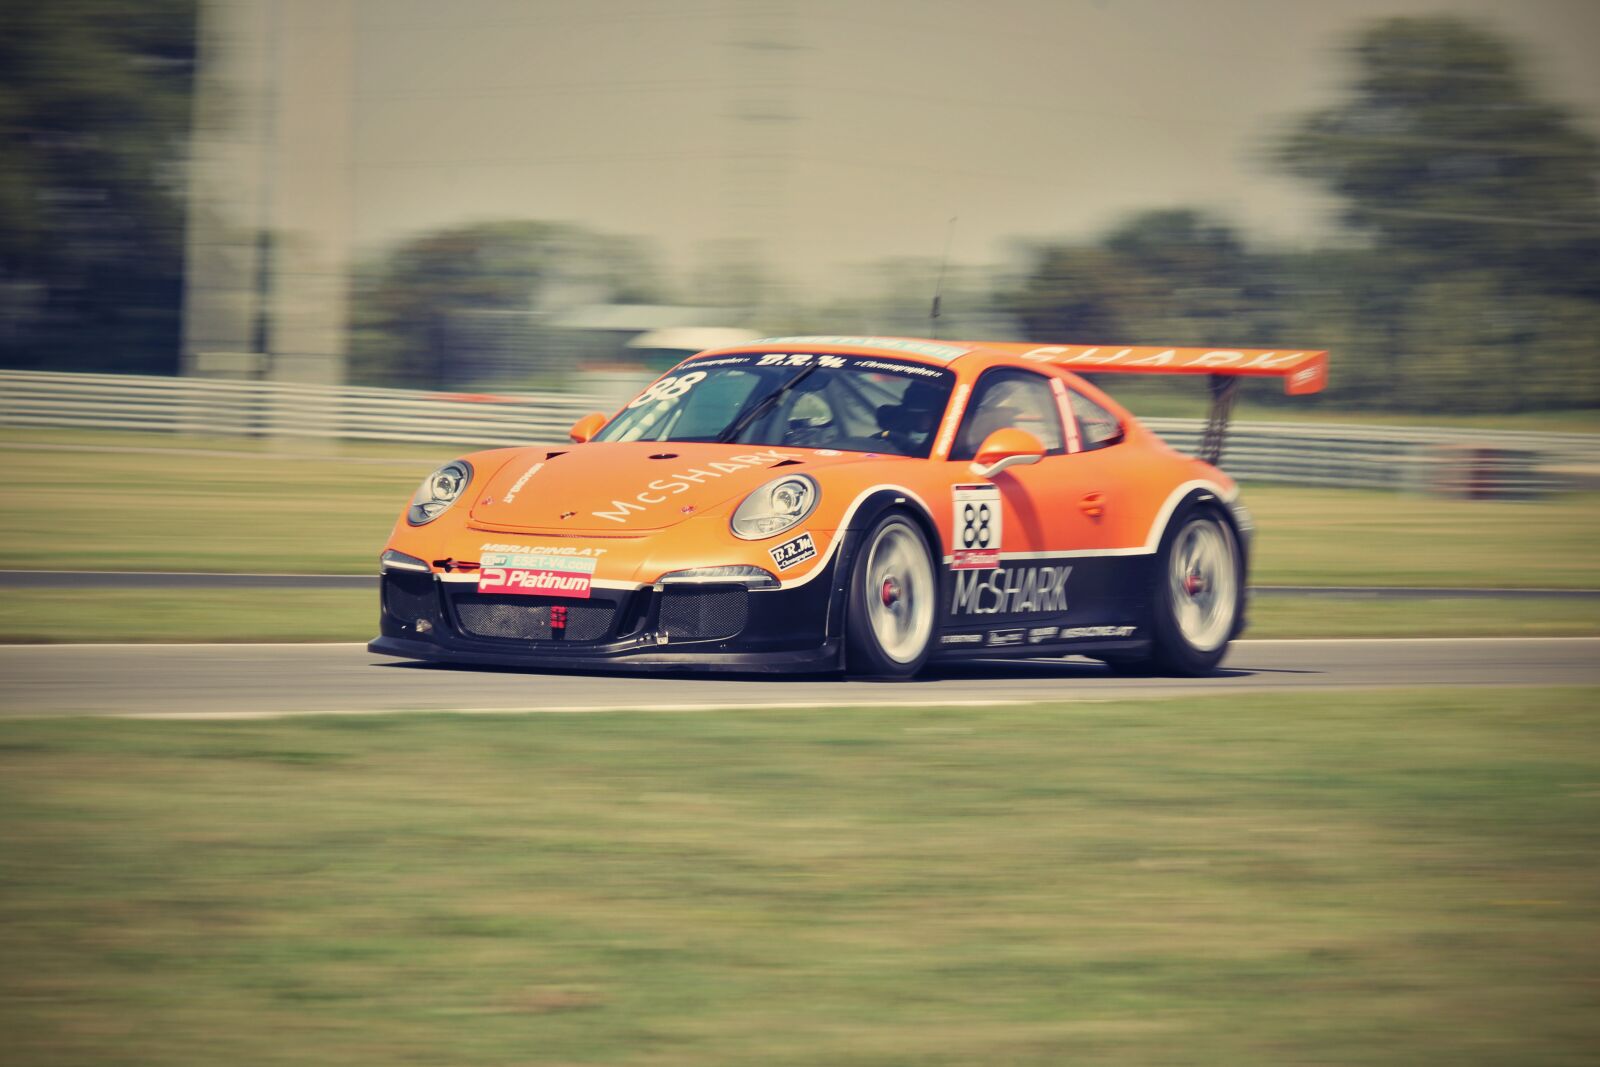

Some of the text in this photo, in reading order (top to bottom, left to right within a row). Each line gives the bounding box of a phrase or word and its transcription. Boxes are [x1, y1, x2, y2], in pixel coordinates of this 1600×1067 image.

[1020, 346, 1304, 368] SHARK
[628, 371, 708, 408] 88
[592, 449, 803, 523] McSHARK
[963, 503, 991, 548] 88
[506, 570, 589, 591] Platinum
[951, 566, 1073, 615] McSHARK
